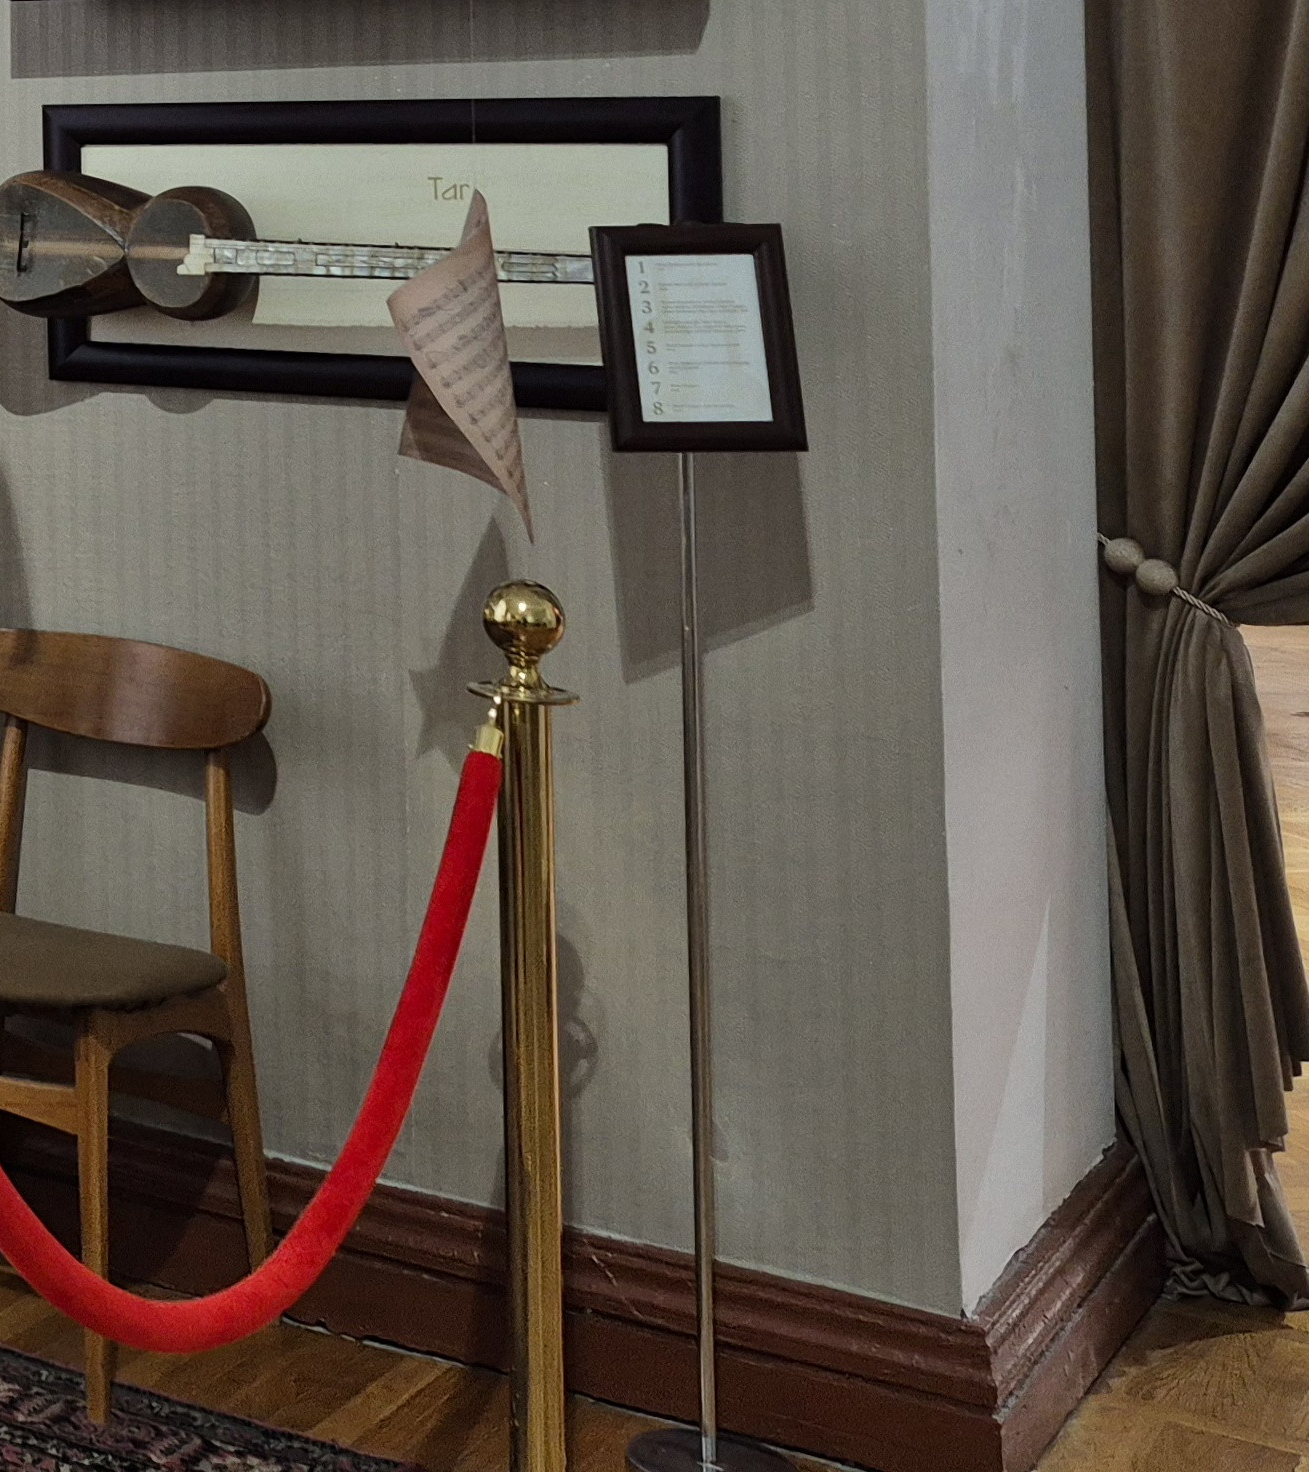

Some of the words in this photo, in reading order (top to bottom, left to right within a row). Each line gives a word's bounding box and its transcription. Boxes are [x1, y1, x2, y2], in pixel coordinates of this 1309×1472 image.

[427, 176, 470, 200] Tar
[638, 260, 645, 274] 1
[638, 280, 650, 294] 2
[642, 300, 652, 314] 3
[644, 321, 655, 334] 4
[647, 340, 656, 354] 5
[648, 361, 659, 375] 6
[650, 381, 661, 395] 7
[653, 401, 663, 416] 8
